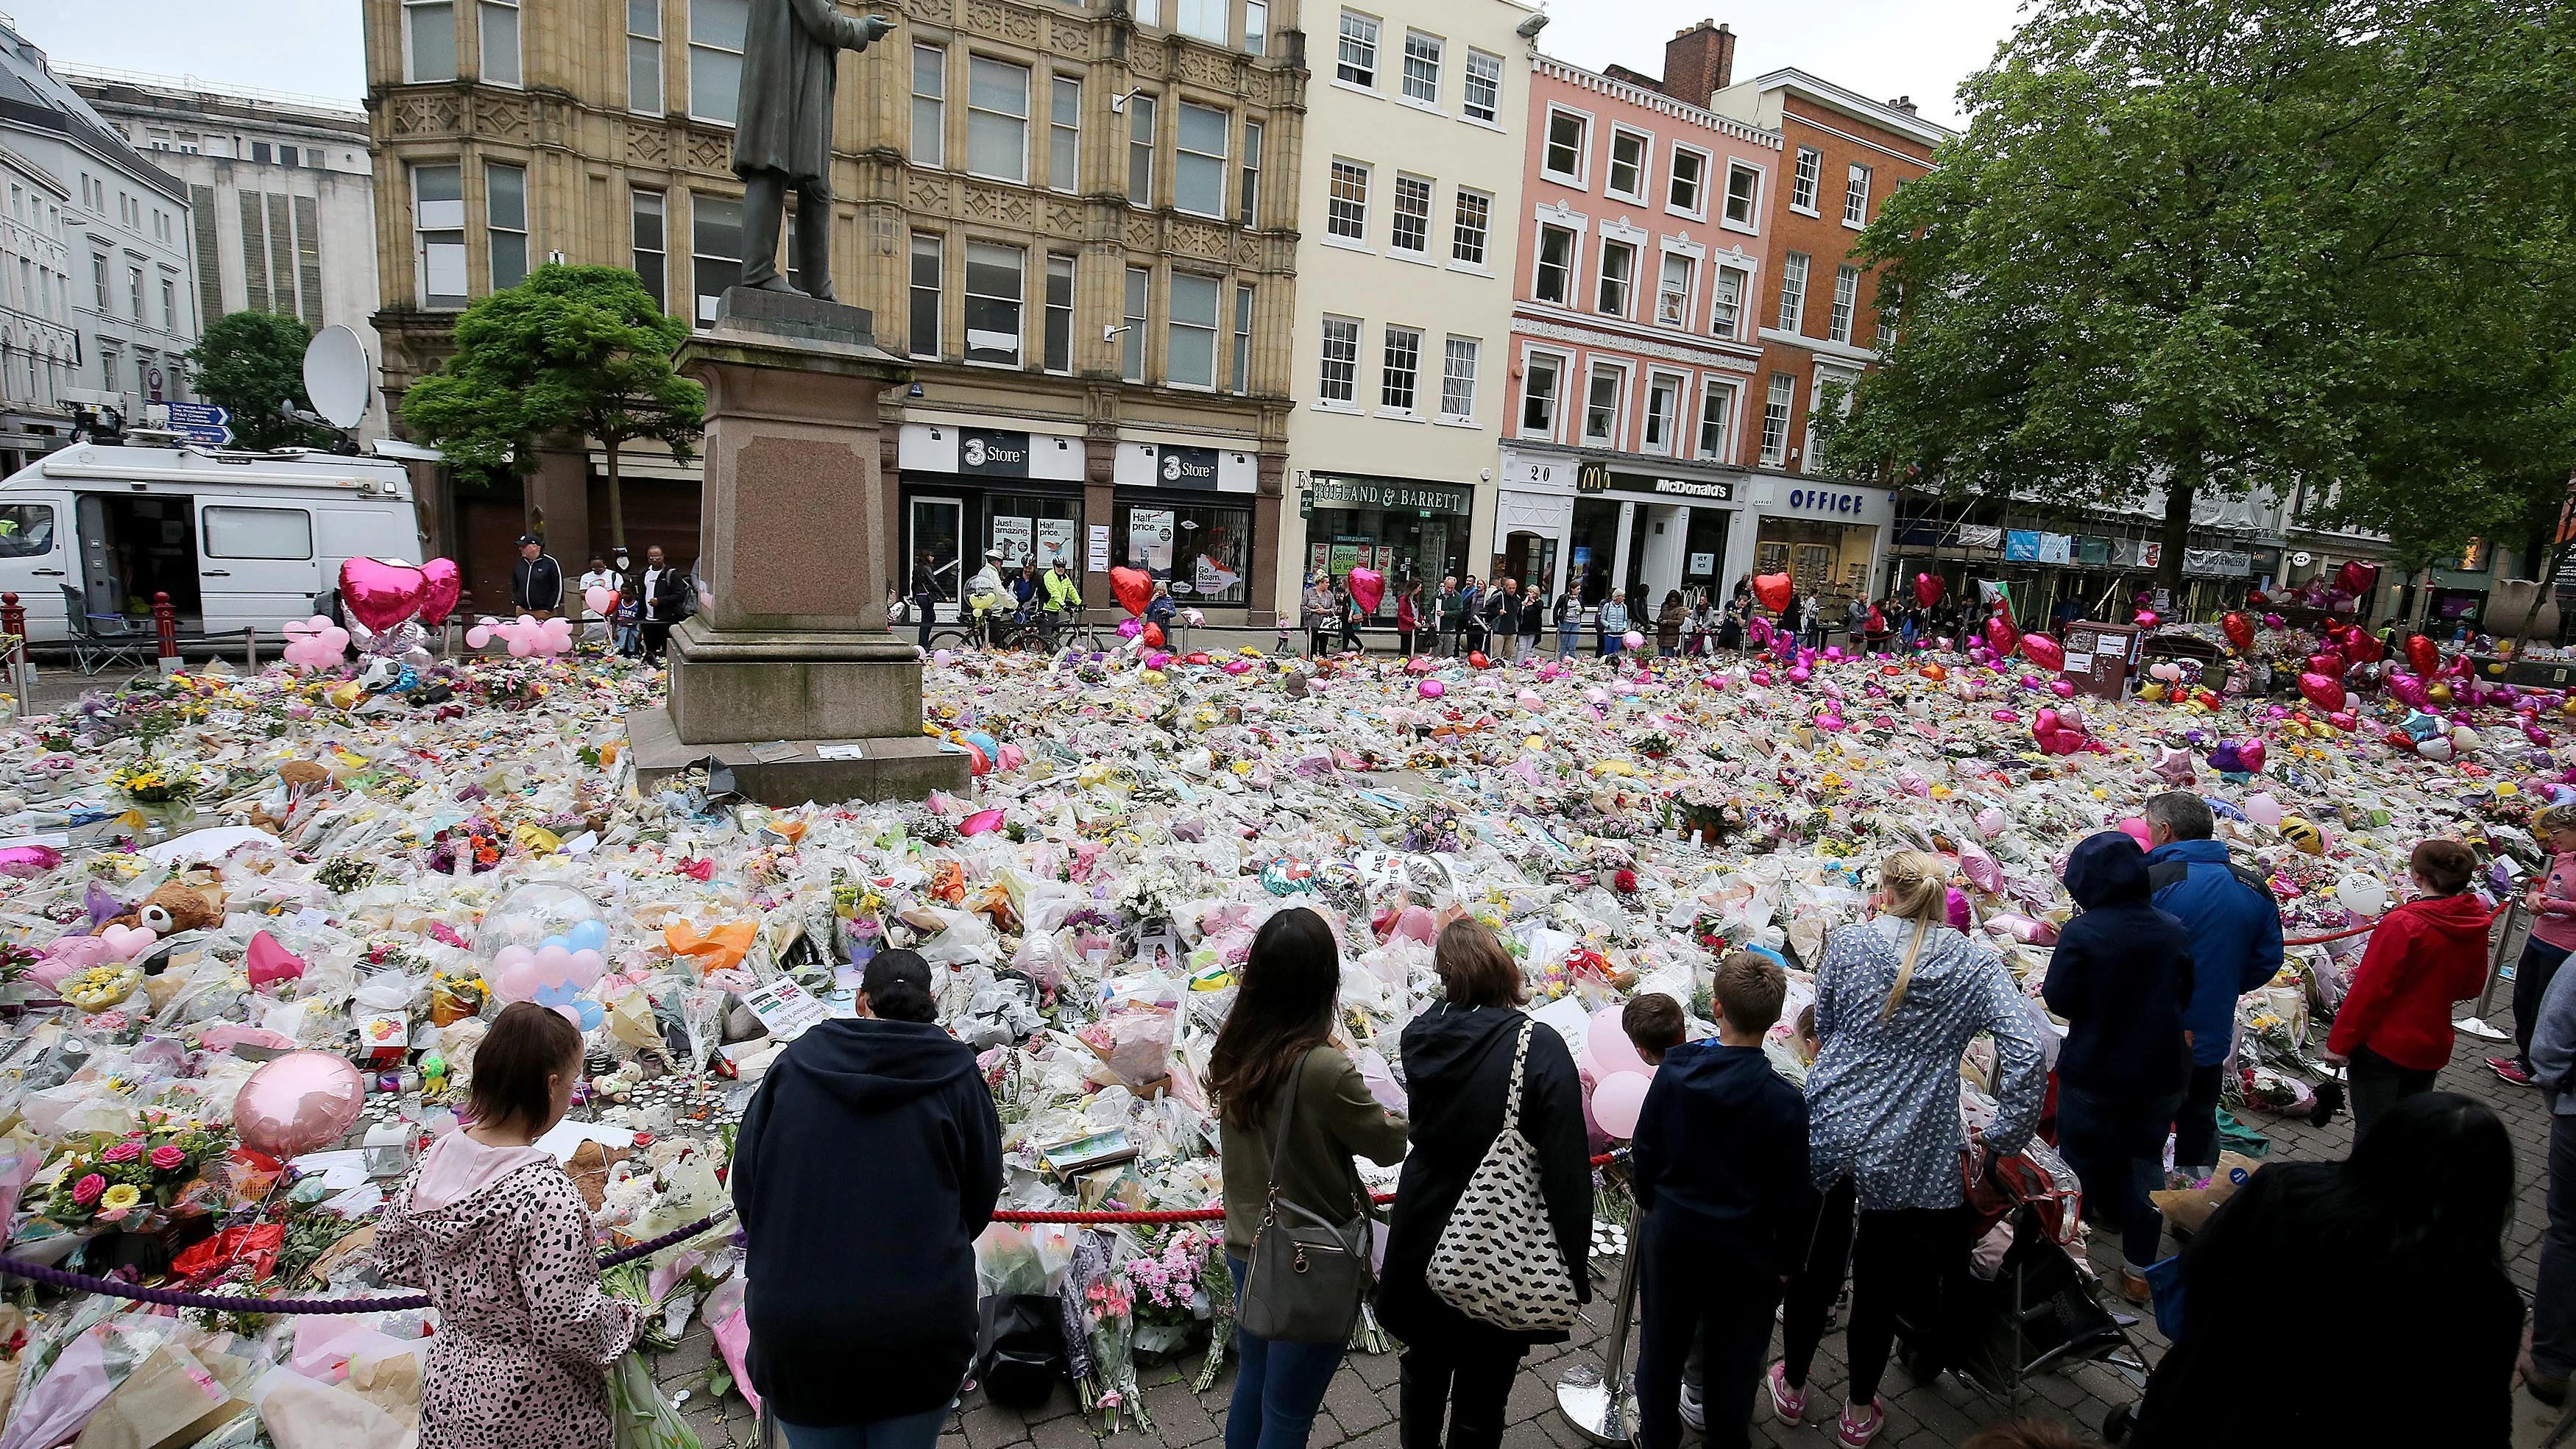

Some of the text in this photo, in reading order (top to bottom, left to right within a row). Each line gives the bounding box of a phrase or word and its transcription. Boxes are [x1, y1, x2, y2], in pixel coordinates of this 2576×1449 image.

[965, 438, 1020, 466] 3 Store
[1163, 455, 1210, 481] 3 Store
[1655, 479, 1727, 497] McDonald's
[1313, 483, 1461, 512] HOLLAND & BARRETT
[1790, 489, 1864, 514] OFFICE
[1133, 513, 1151, 522] Half
[995, 519, 1012, 527] Just
[1039, 521, 1055, 529] Half
[1132, 522, 1157, 531] price.
[995, 528, 1030, 536] amazing.
[1039, 528, 1061, 537] price.
[1334, 551, 1356, 561] better
[2352, 879, 2374, 889] MCR
